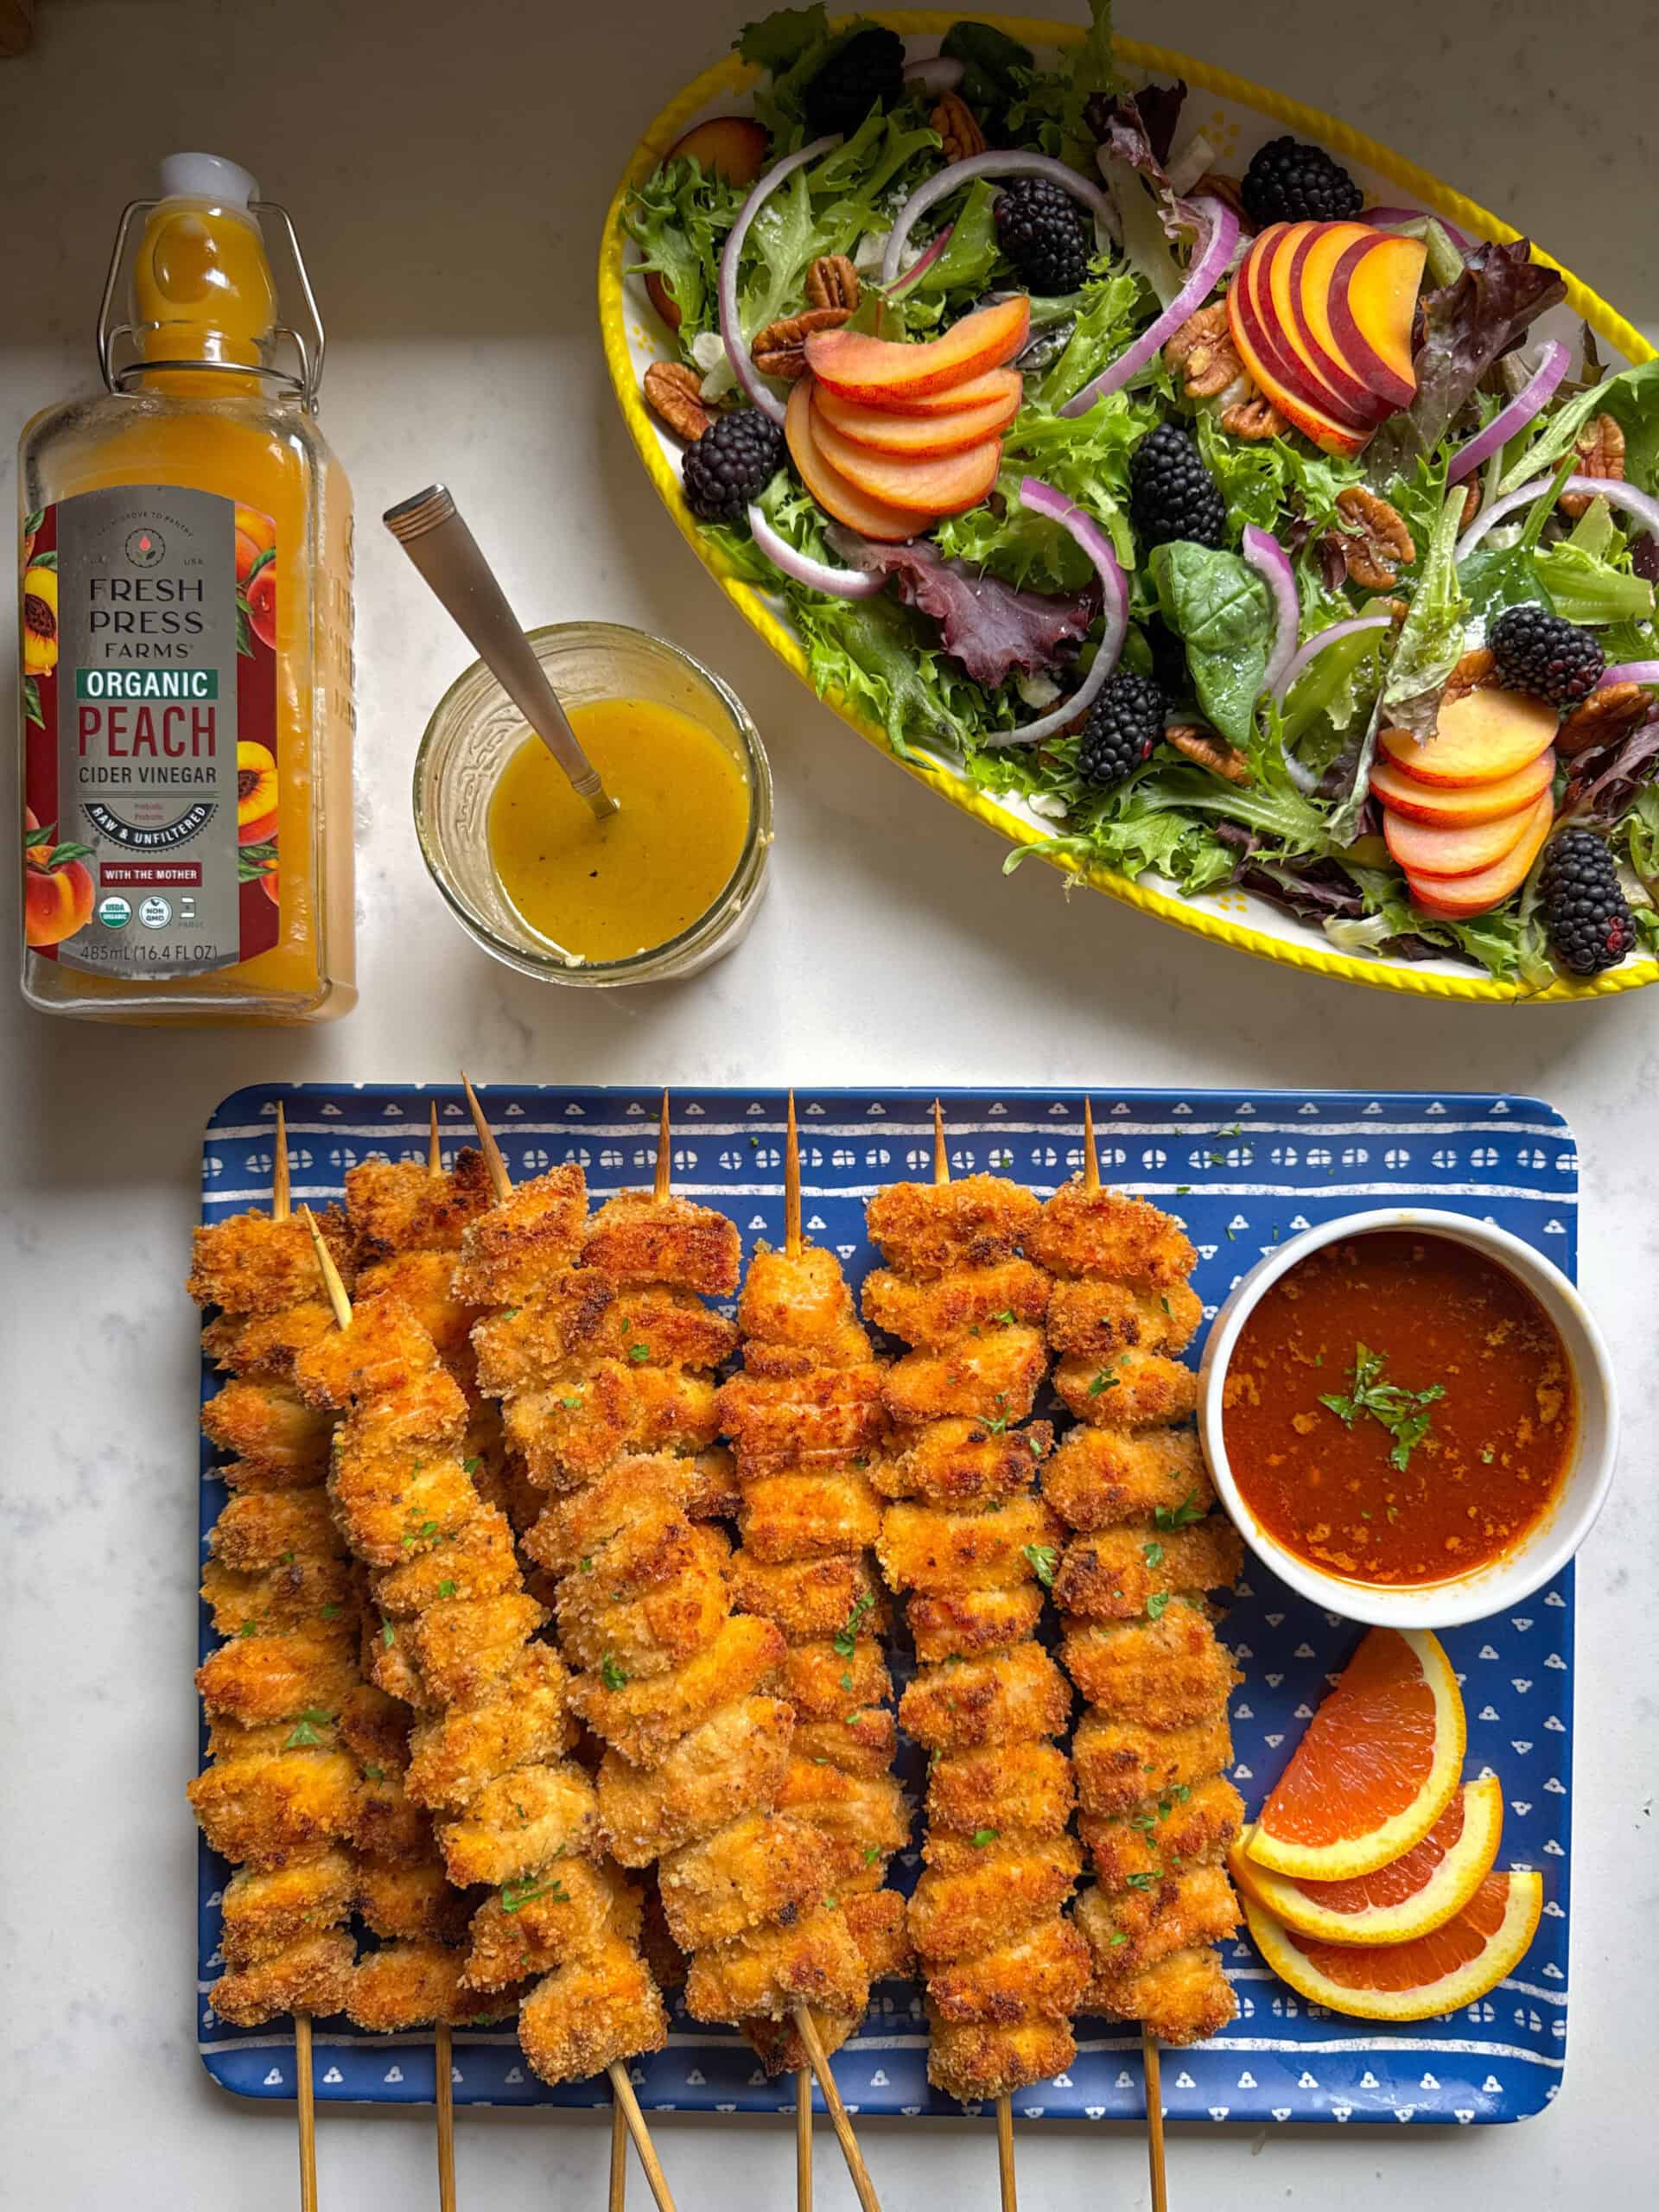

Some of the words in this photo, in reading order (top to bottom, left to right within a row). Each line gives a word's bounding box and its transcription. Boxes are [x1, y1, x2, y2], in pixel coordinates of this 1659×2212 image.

[90, 578, 203, 602] FRESH
[90, 611, 203, 634] PRESS
[105, 643, 189, 658] FARMS
[86, 671, 208, 697] ORGANIC
[79, 705, 216, 758] PEACH
[79, 766, 132, 784] CIDER
[138, 766, 216, 784] VINEGAR
[92, 806, 118, 831] RAW
[118, 828, 129, 841] &
[134, 806, 207, 844] UNFILTERED
[105, 869, 131, 880] WITH
[135, 869, 153, 880] THE
[156, 869, 197, 880] MOTHER
[105, 903, 125, 912] USDA
[80, 945, 130, 961] 485mL
[134, 945, 170, 962] (16.4
[175, 945, 190, 961] FL
[194, 945, 218, 962] OZ)
